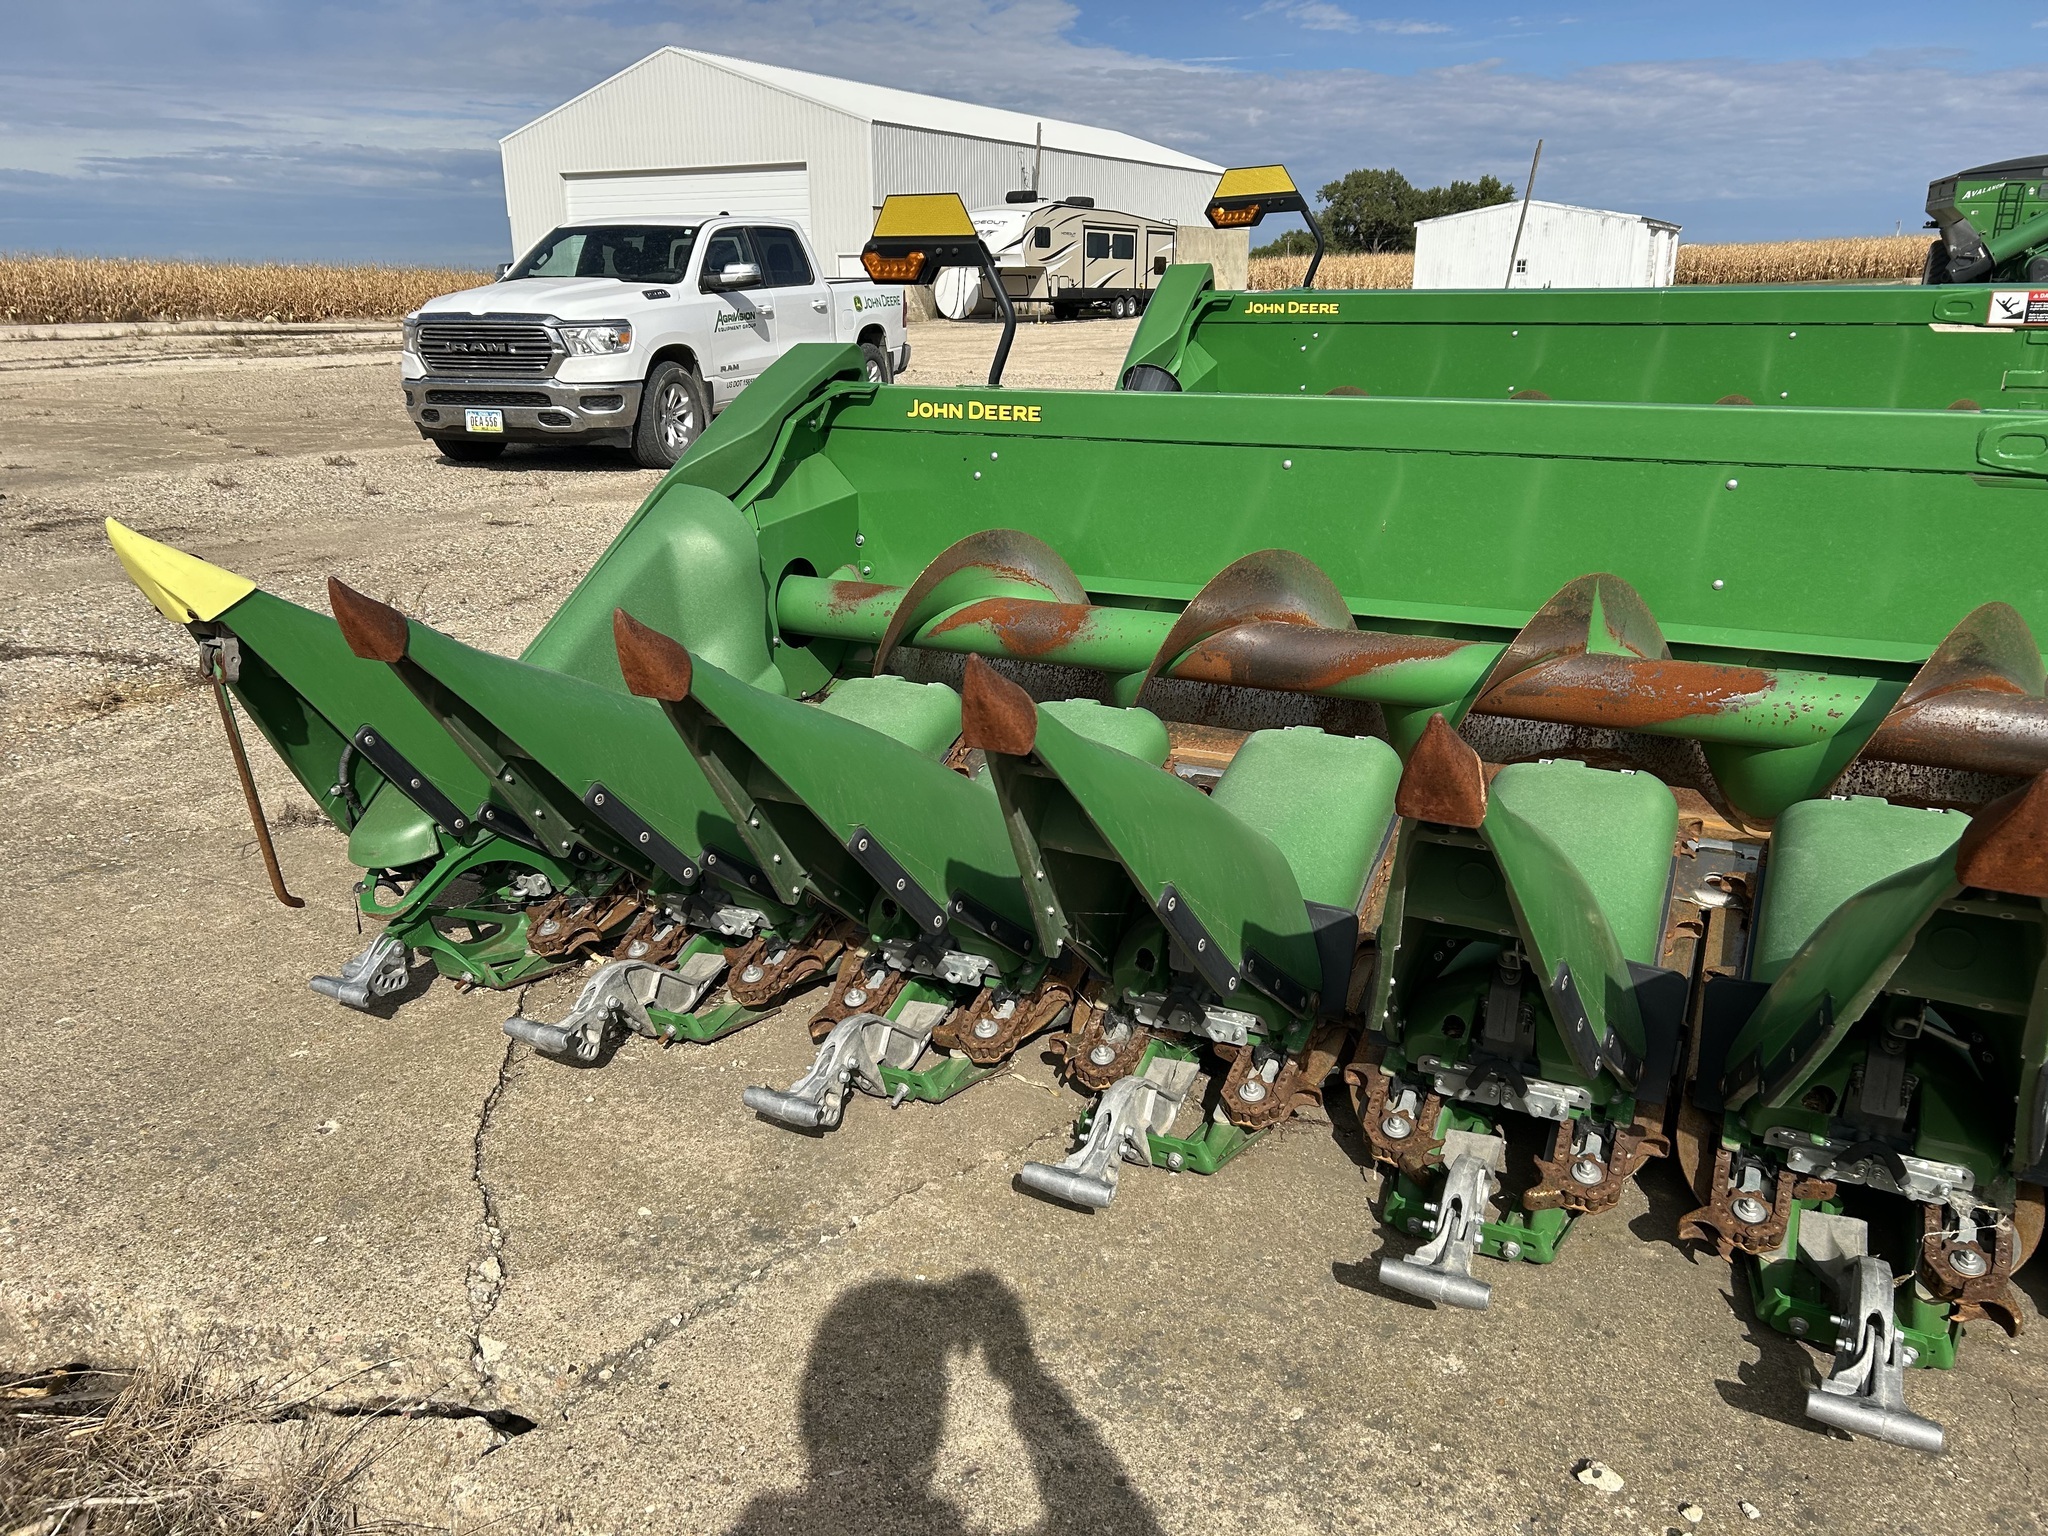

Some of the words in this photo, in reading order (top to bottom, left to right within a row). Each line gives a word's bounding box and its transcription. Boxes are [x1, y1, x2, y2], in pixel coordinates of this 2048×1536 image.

[973, 219, 1008, 227] DEOUT
[864, 295, 882, 309] JOHN
[880, 294, 901, 307] DEERE
[1244, 301, 1285, 314] JOHN
[1288, 301, 1339, 314] DEERE
[718, 324, 742, 333] EQUIPMENT
[452, 342, 506, 352] RAM
[720, 363, 740, 372] RAM
[907, 399, 963, 419] JOHN
[968, 400, 1042, 422] DEERE
